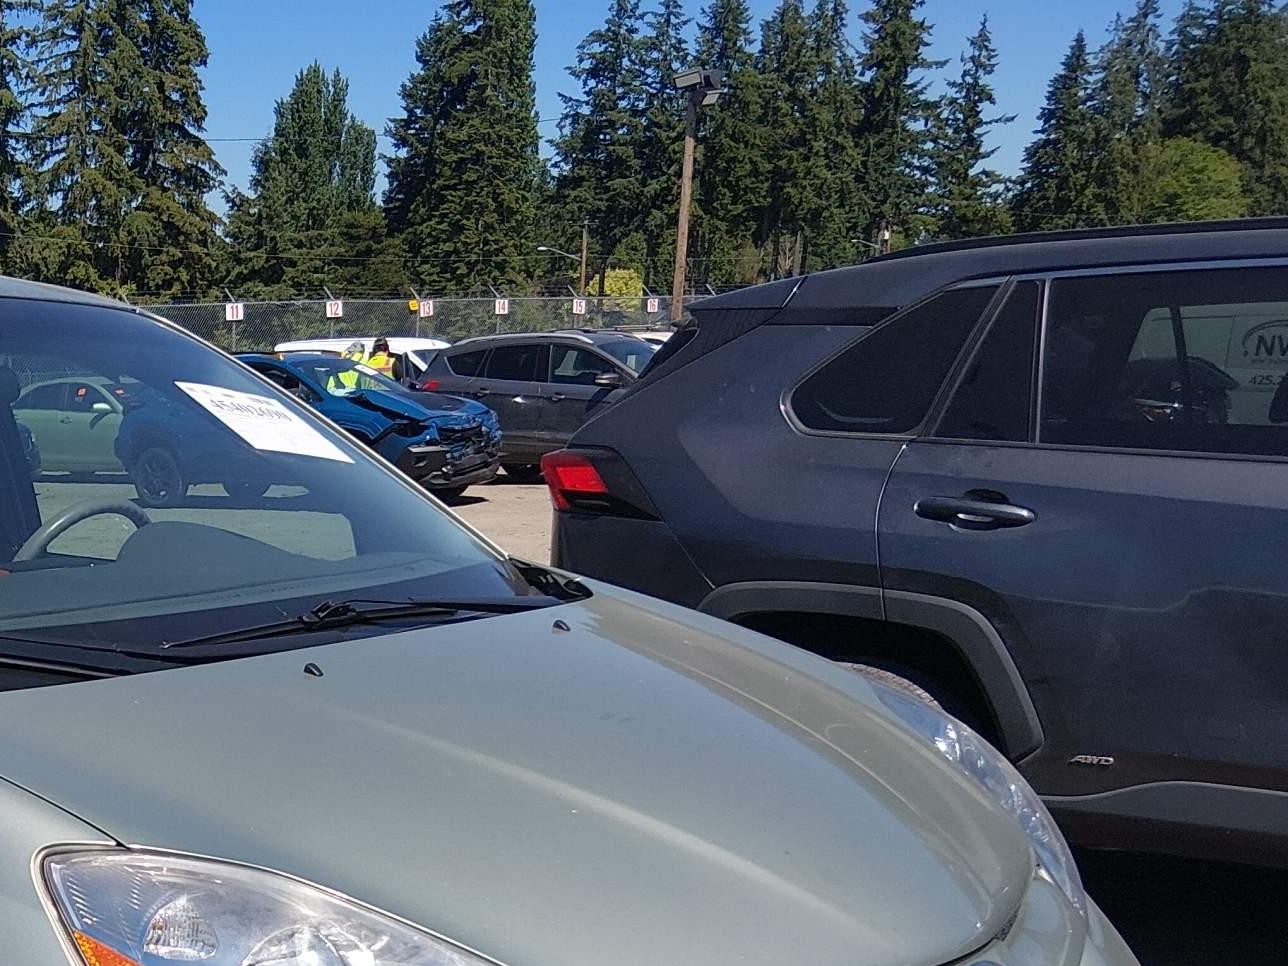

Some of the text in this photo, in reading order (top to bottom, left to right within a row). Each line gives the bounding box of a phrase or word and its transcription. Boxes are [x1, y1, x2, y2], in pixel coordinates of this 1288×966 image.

[329, 303, 340, 317] 12
[422, 302, 431, 316] 13
[497, 301, 506, 313] 14
[575, 301, 583, 313] 15
[649, 300, 657, 311] 16
[230, 305, 239, 319] 11
[1068, 755, 1114, 765] AWD
